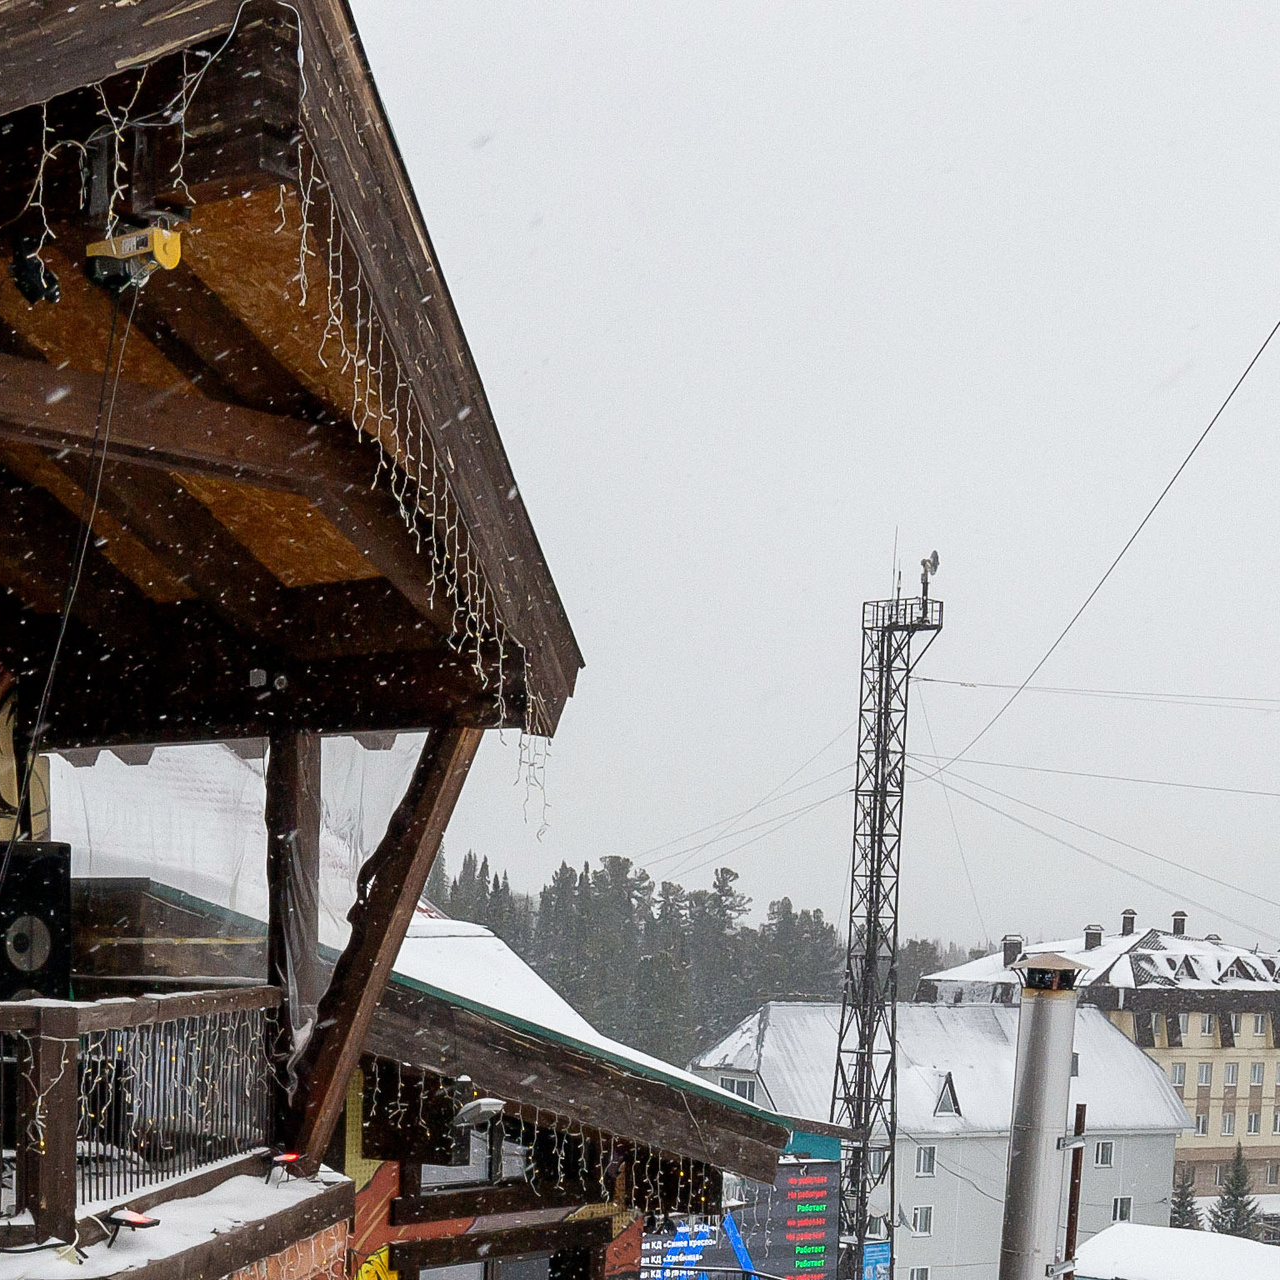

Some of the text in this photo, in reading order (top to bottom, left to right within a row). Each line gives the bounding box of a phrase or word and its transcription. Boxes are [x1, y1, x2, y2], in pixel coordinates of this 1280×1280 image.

[797, 1204, 827, 1212] Работает
[796, 1246, 826, 1254] Работает
[795, 1260, 825, 1268] Работает
